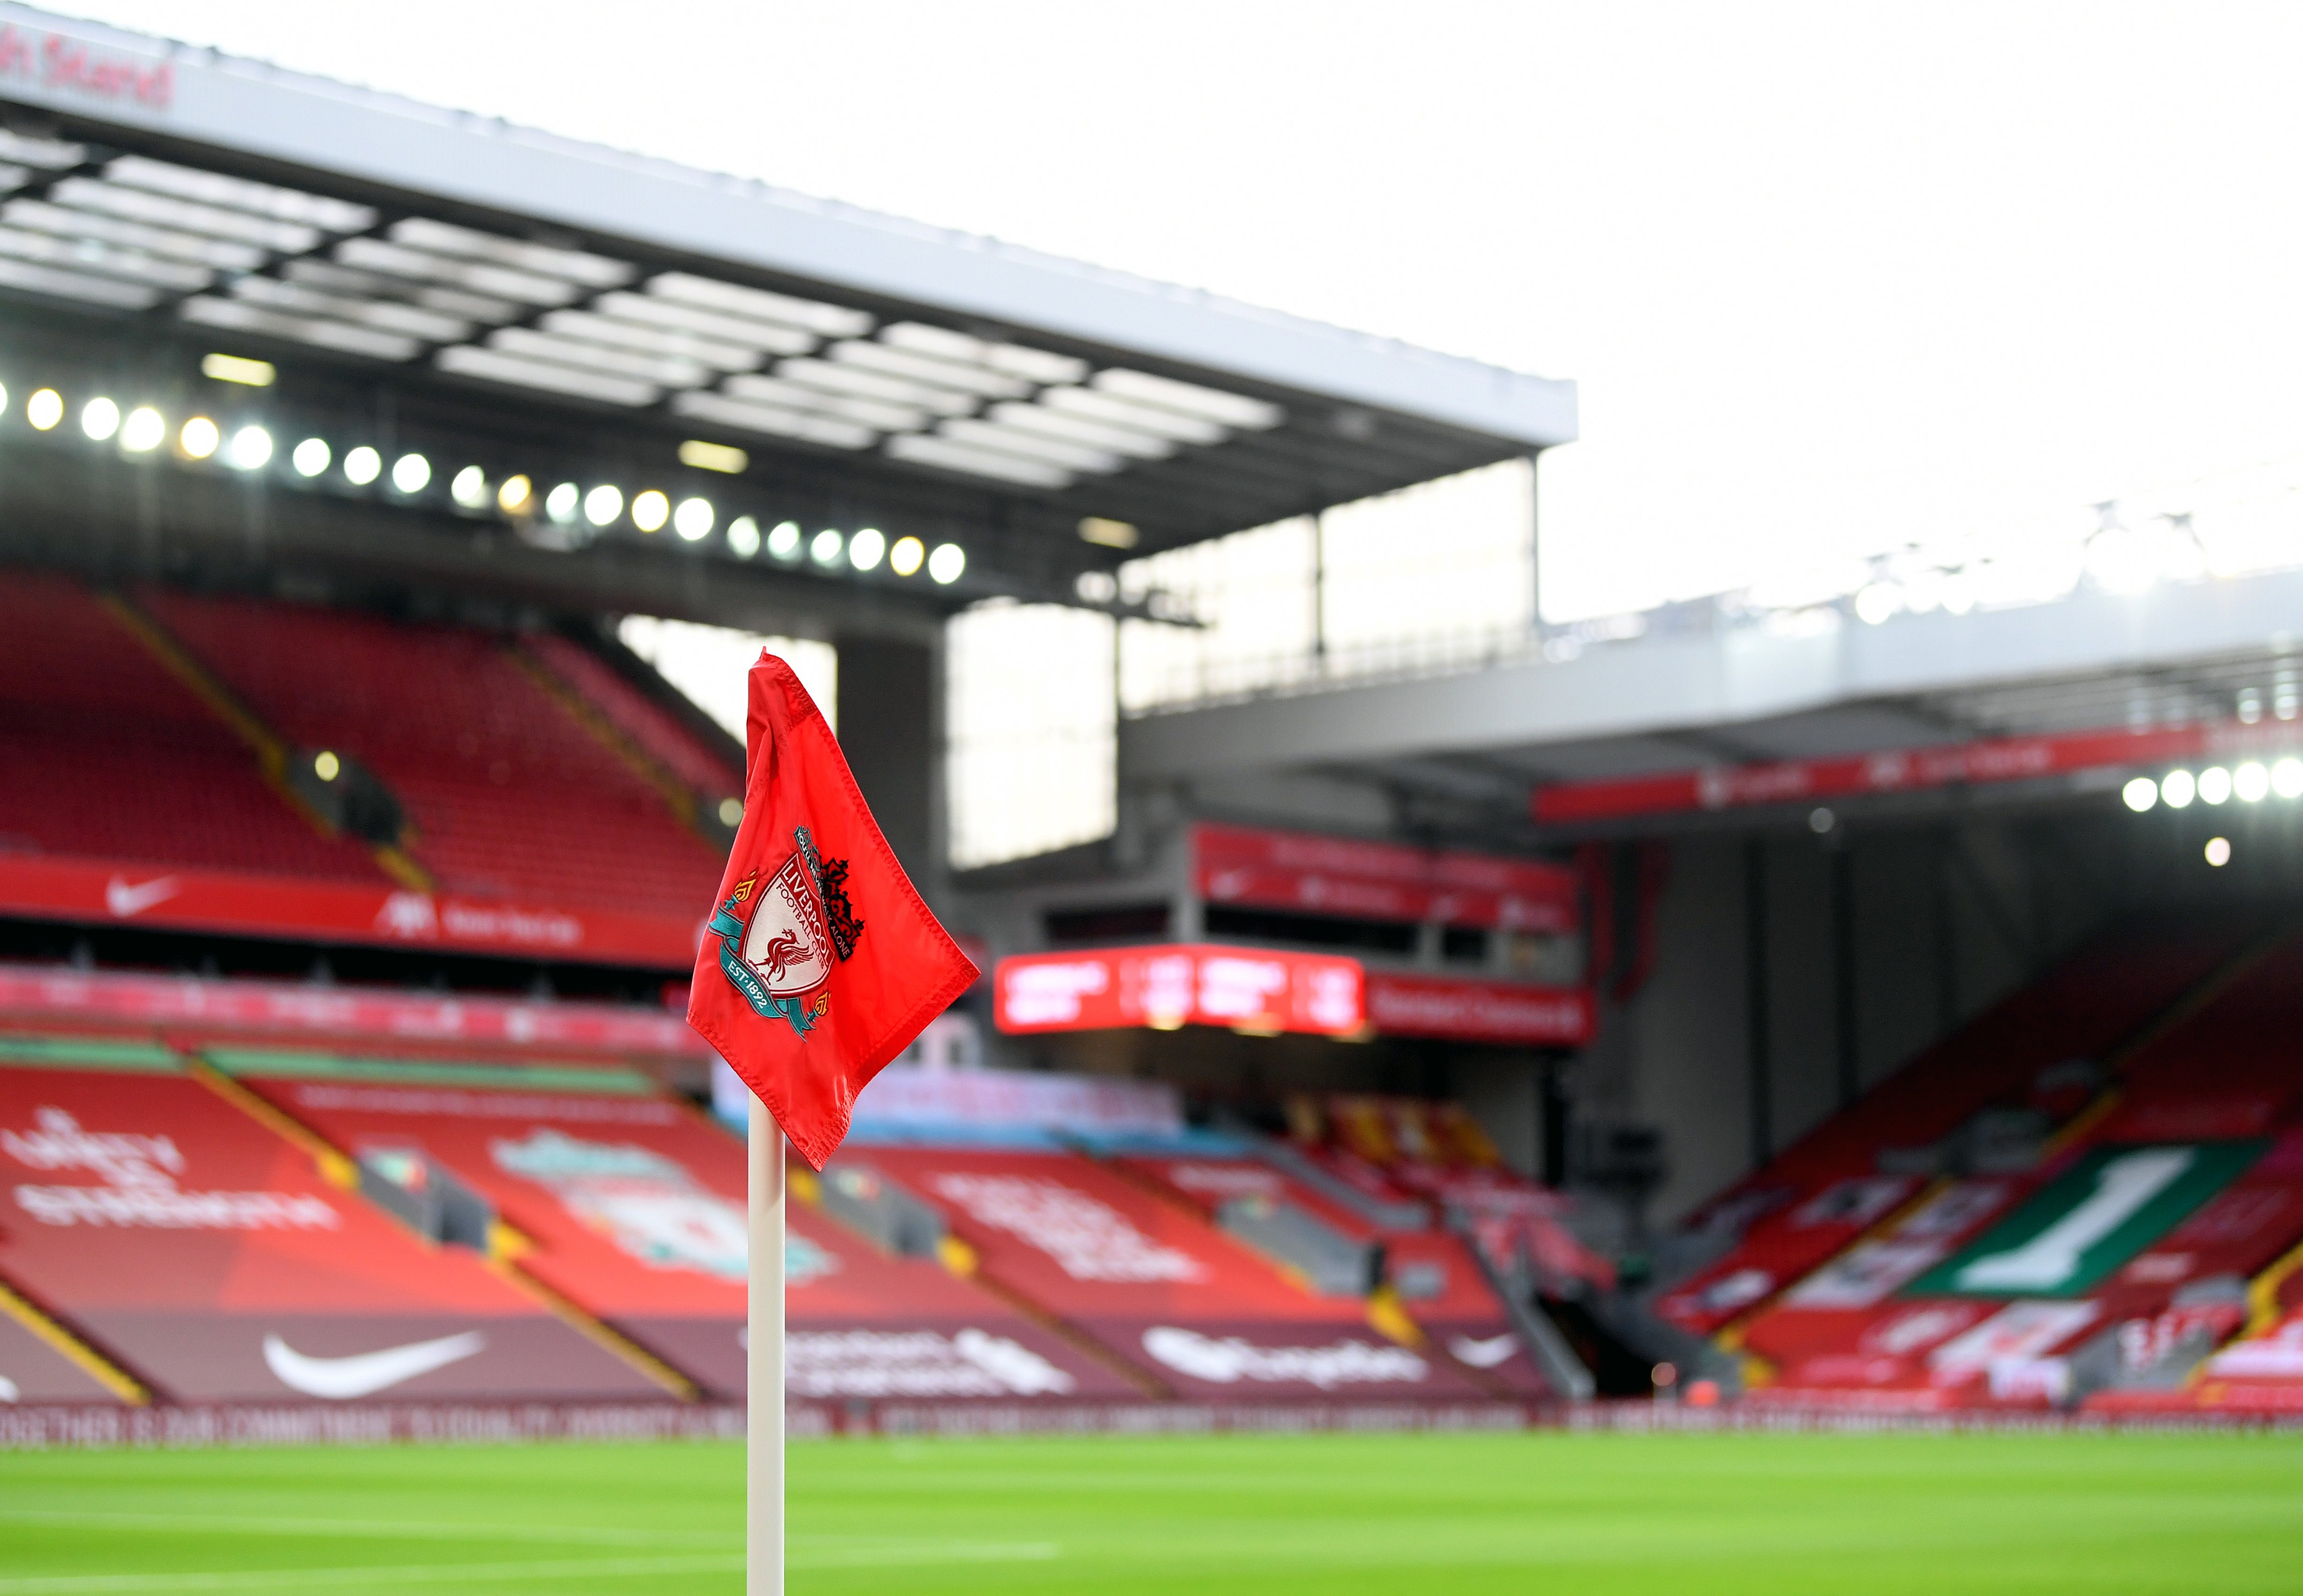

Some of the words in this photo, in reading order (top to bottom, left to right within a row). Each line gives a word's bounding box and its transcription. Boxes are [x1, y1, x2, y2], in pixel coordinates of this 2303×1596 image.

[775, 881, 810, 940] FOOTBALL
[812, 941, 824, 970] CLUB
[782, 863, 829, 966] LIVERPOOL
[797, 828, 810, 864] YOU'LL
[830, 926, 850, 957] ALONE
